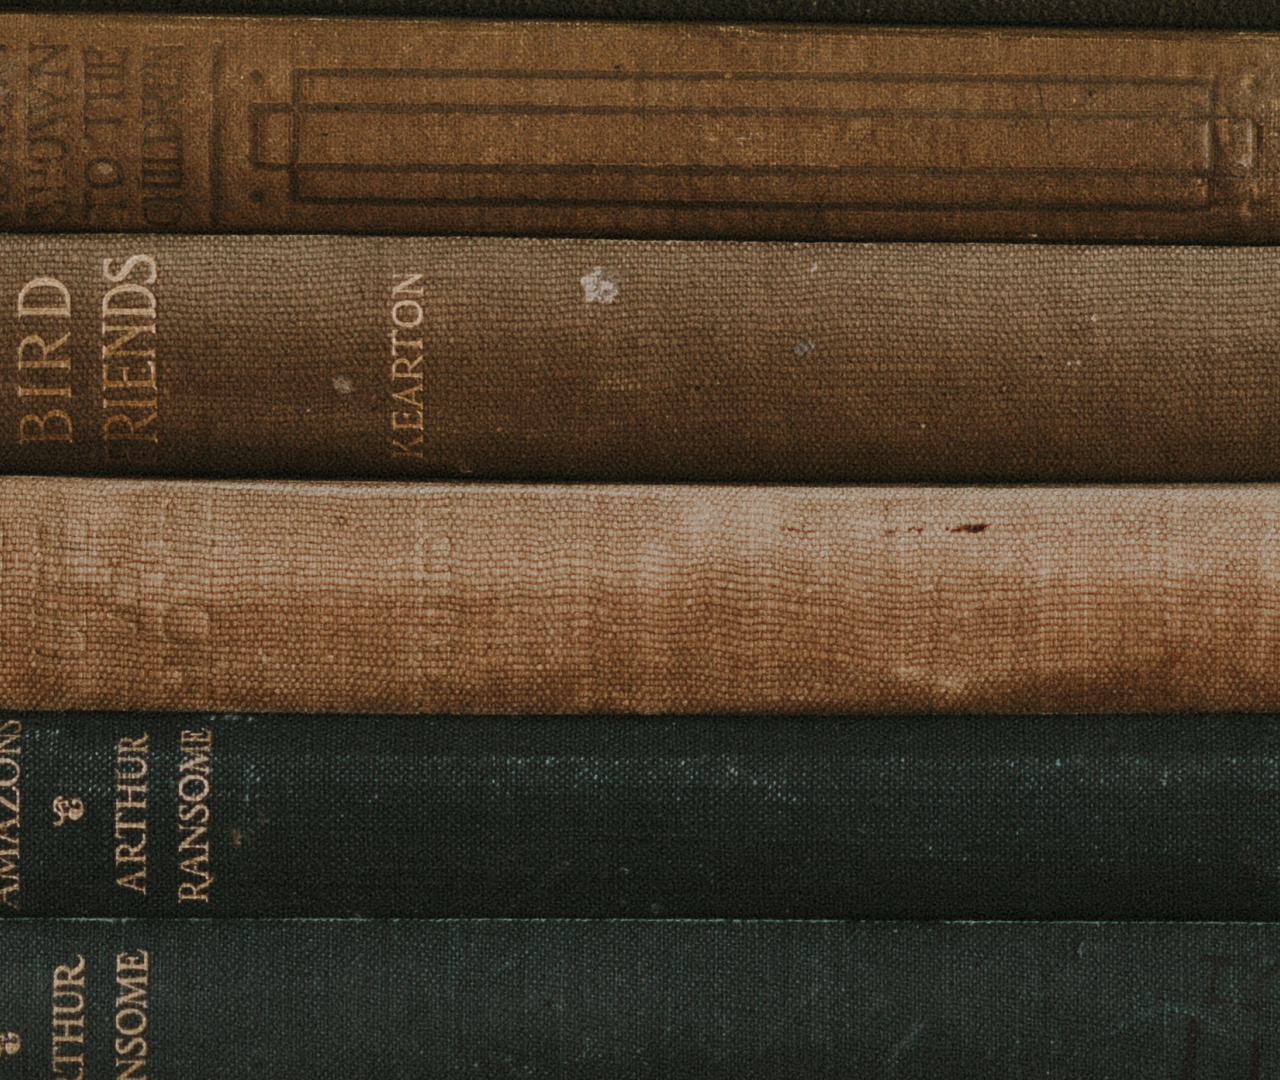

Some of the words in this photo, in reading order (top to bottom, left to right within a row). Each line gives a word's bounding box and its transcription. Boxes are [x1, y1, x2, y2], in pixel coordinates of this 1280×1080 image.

[83, 46, 126, 140] THE
[84, 158, 126, 221] TO
[17, 276, 72, 443] BIRD
[390, 273, 425, 459] KEARTON
[115, 733, 148, 895] ARTHUR
[178, 727, 213, 903] RANSOME
